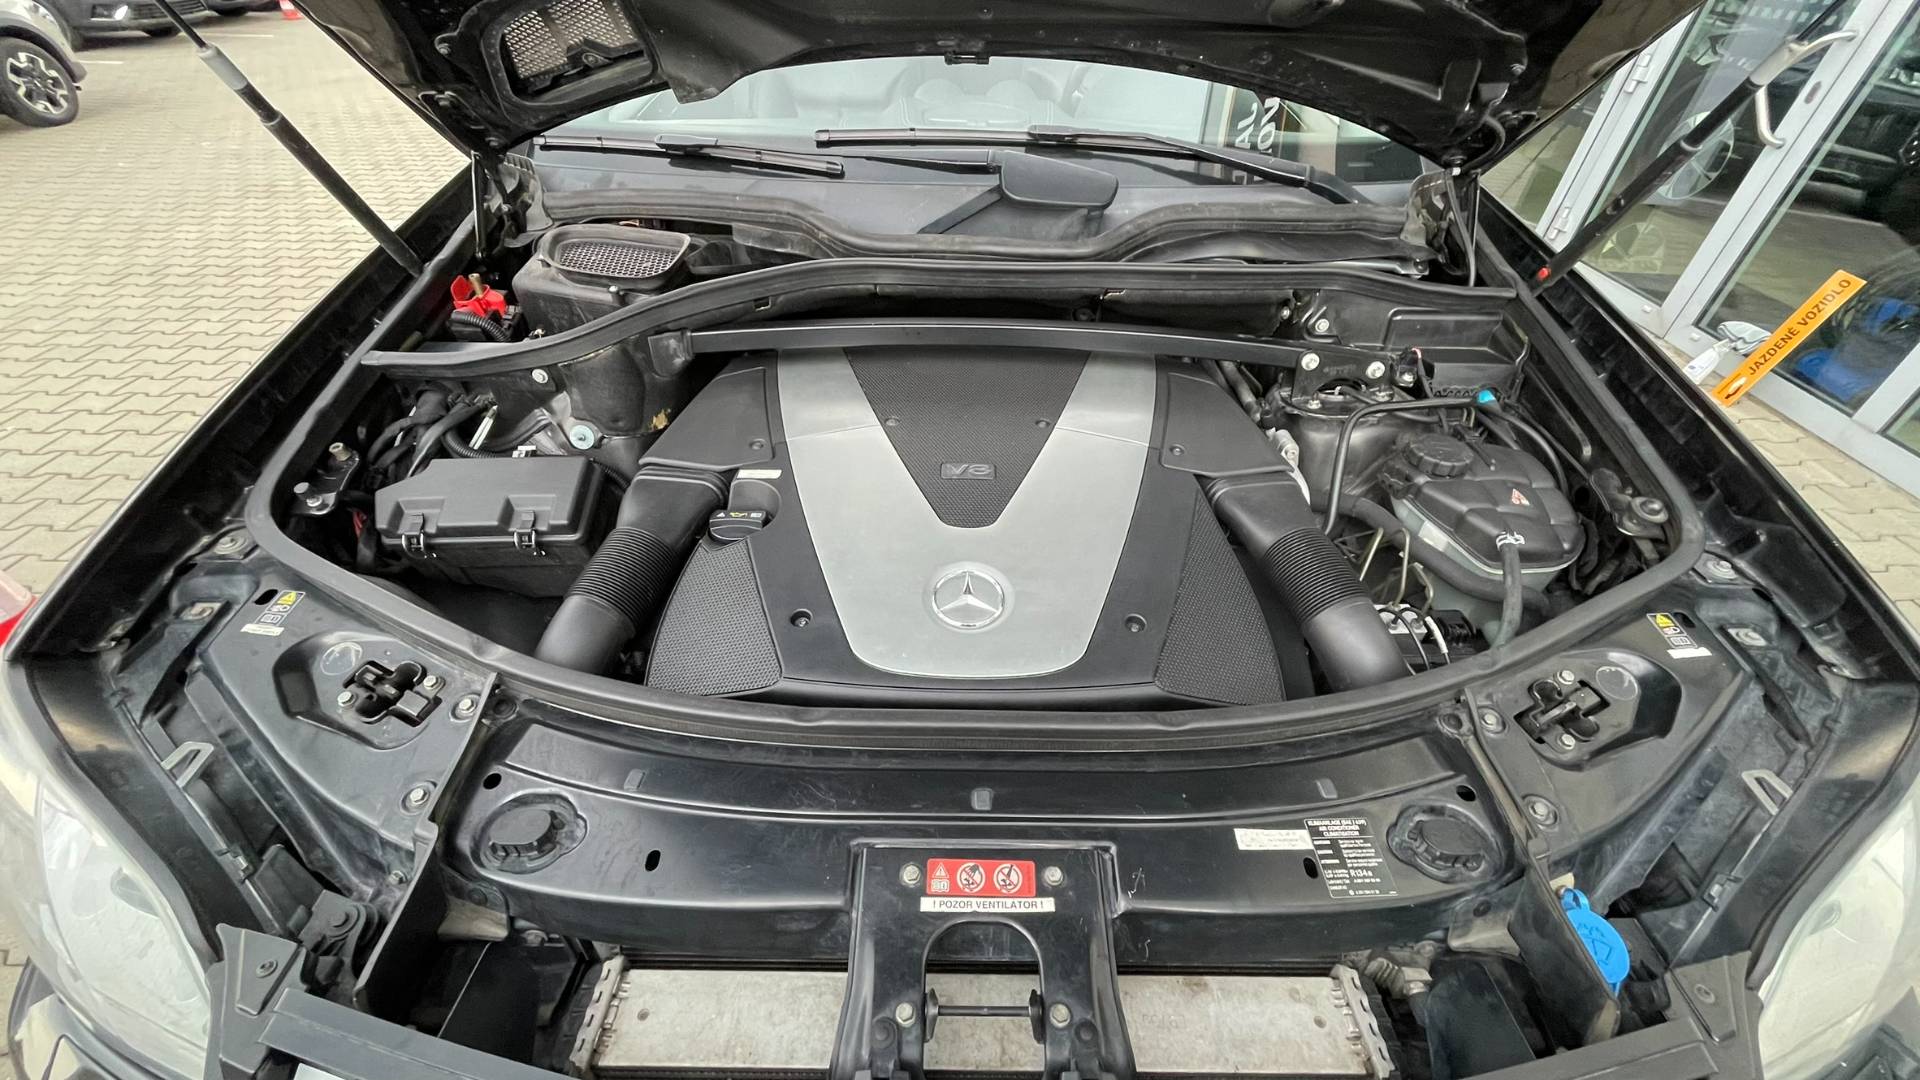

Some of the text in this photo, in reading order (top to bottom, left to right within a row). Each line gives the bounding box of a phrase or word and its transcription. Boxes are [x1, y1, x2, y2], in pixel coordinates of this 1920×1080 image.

[1797, 279, 1851, 327] VOZIDLO
[939, 901, 973, 909] POZOR
[975, 901, 1038, 909] VENTILATOR
